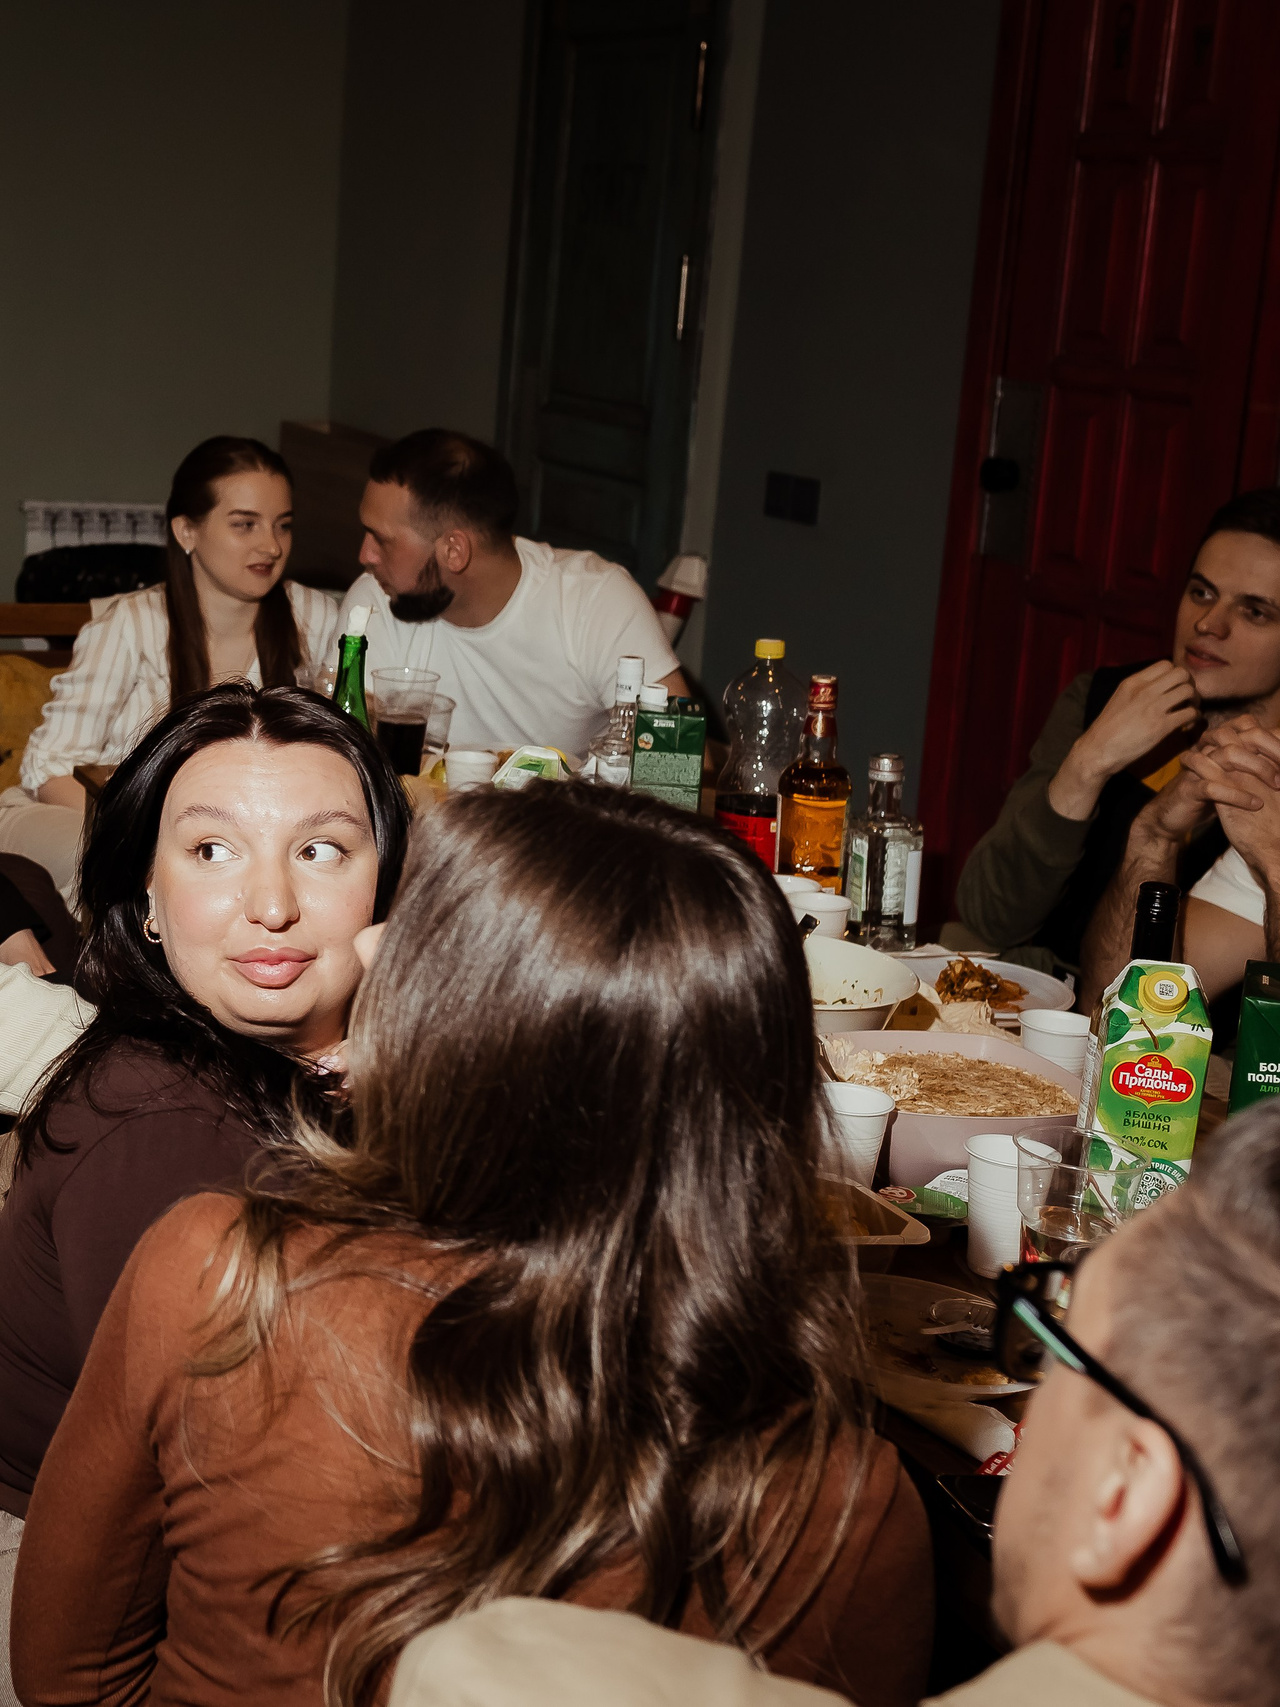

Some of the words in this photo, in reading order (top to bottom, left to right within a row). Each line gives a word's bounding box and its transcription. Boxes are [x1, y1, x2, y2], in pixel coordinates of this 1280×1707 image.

[1134, 1063, 1173, 1081] Сады
[1118, 1071, 1187, 1094] Придонья
[1259, 1084, 1280, 1093] ДЛЯ
[1125, 1110, 1171, 1123] ЯБЛОКО
[1123, 1118, 1171, 1133] ВИШНЯ
[1147, 1139, 1168, 1151] СОК
